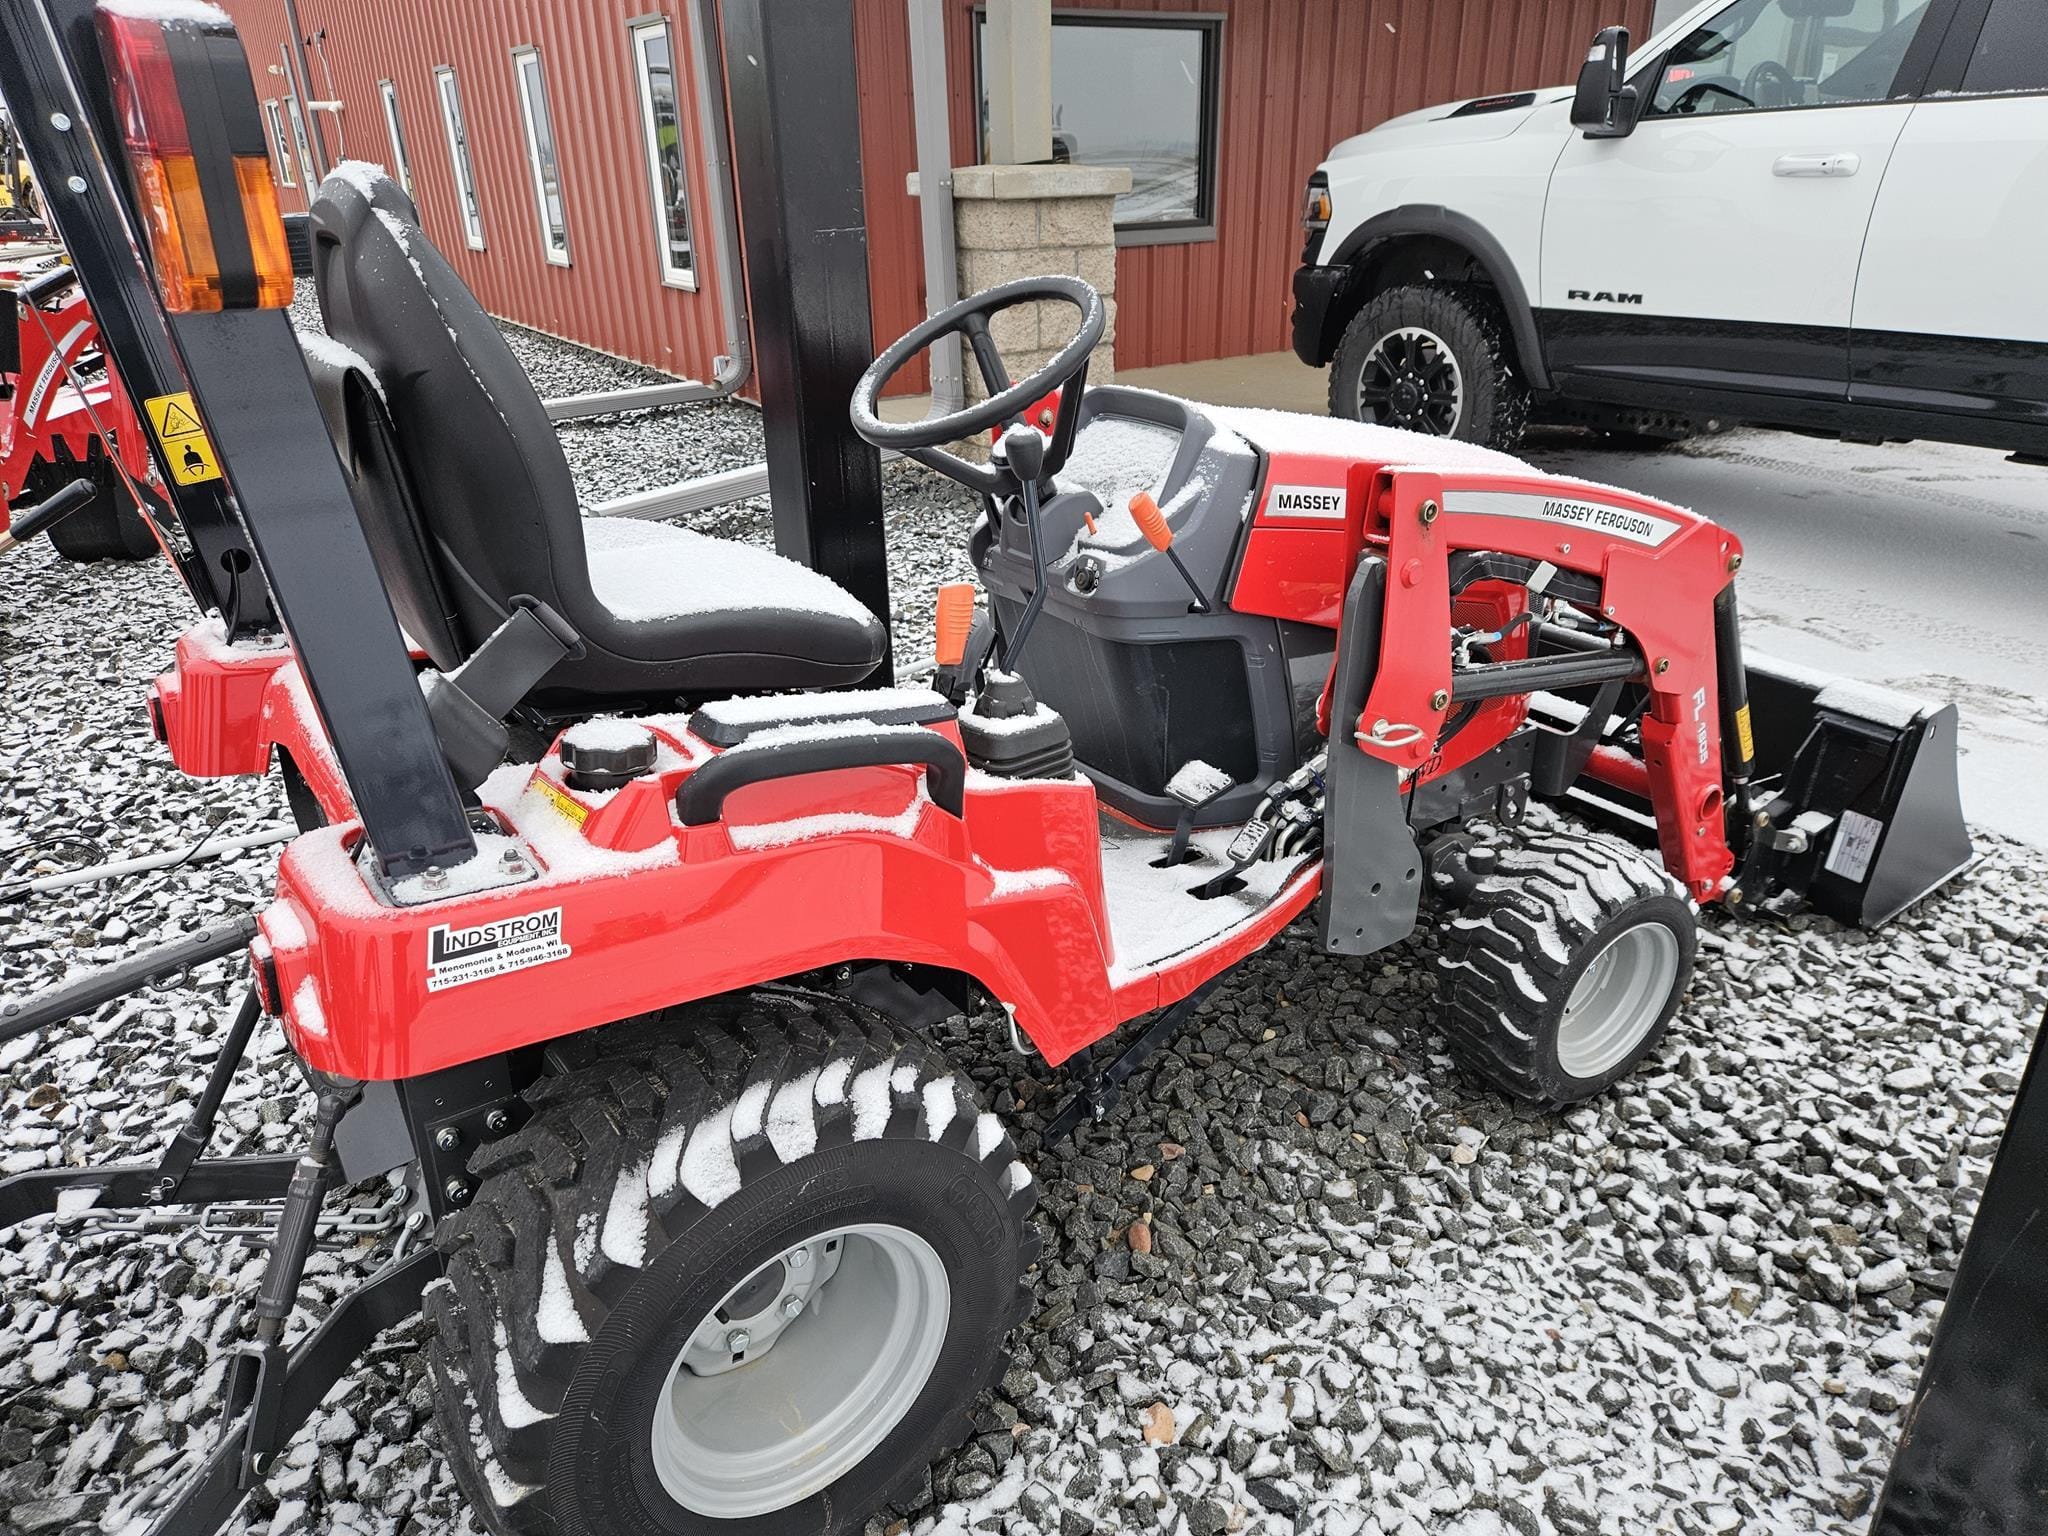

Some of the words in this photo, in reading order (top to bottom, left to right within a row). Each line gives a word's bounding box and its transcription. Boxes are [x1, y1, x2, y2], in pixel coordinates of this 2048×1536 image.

[1568, 290, 1643, 304] RAM
[28, 384, 45, 415] MASSEY
[41, 353, 60, 384] FERGUSO
[1278, 493, 1341, 511] MASSEY
[1542, 501, 1594, 522] MASSEY
[1594, 510, 1654, 537] FERGUSON
[1692, 686, 1706, 722] FL
[432, 911, 558, 964] LINDSTROM
[497, 931, 541, 948] EQUIPMENT,
[541, 927, 556, 938] INC.
[431, 966, 496, 988] 715-231-3168
[507, 947, 568, 969] 715-946-3168
[439, 955, 493, 975] Menomonie
[506, 945, 545, 959] Modena,
[546, 938, 558, 948] WI
